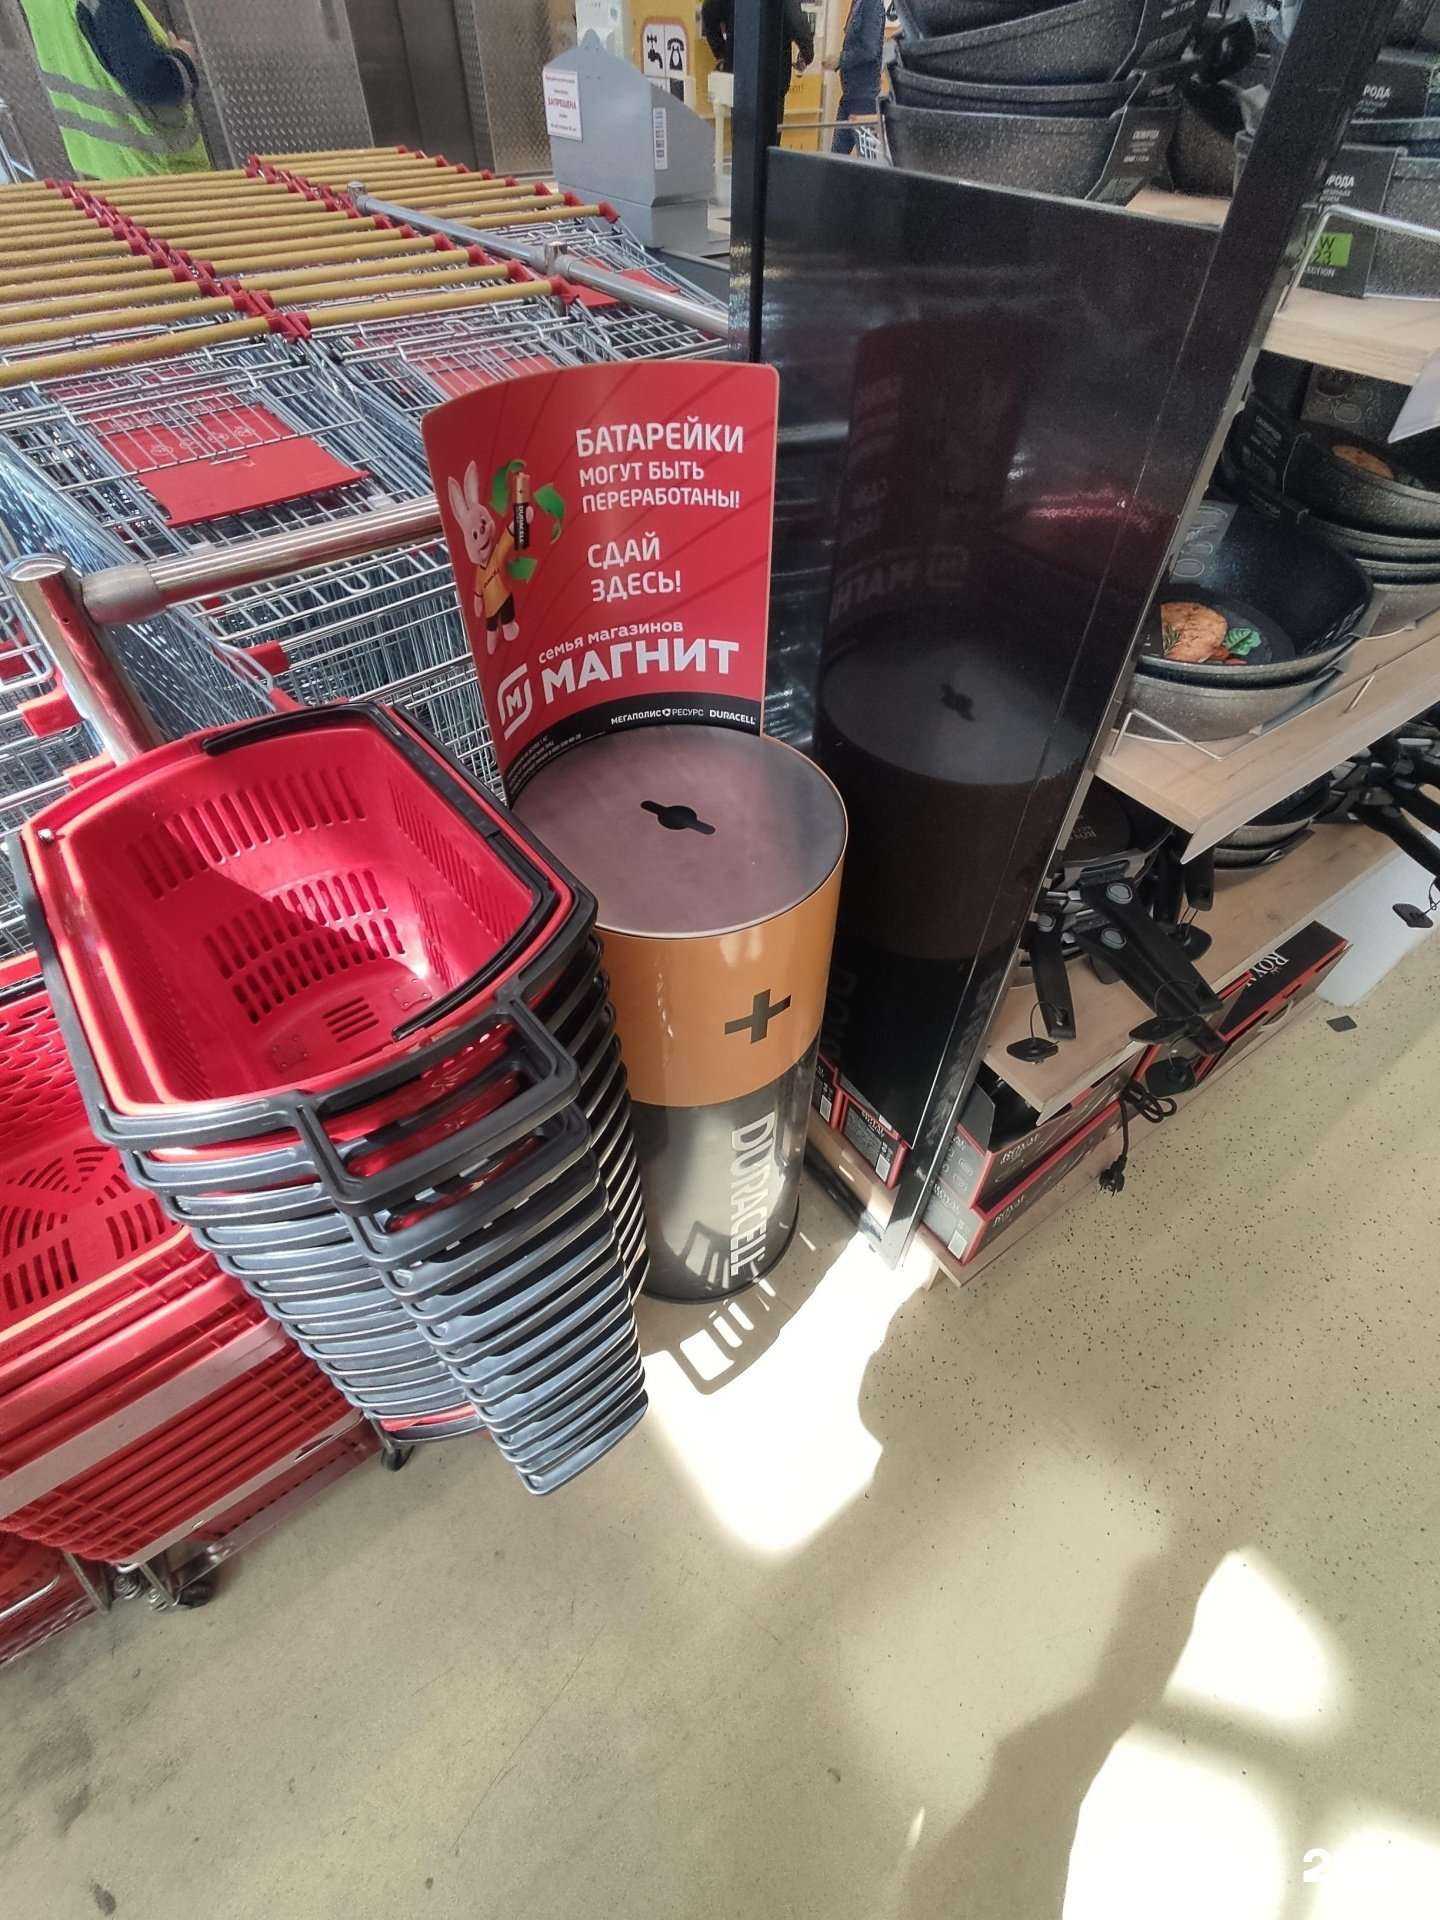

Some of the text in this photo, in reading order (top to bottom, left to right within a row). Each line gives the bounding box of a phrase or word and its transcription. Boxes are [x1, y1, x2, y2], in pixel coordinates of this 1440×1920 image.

[576, 415, 744, 458] БАТАРЕЙКИ
[579, 460, 705, 488] МОГУТ БЫТЬ
[582, 487, 740, 514] ПЕРЕРАБОТАНЫ!
[587, 531, 661, 570] СДАЙ
[590, 569, 682, 604] ЗДЕСЬ!
[538, 620, 684, 665] семья магазинов
[540, 637, 740, 706] МАГНИТ
[610, 707, 705, 726] МЕГАПОЛИС РЕСУРС
[709, 708, 756, 726] DURACELL
[730, 1111, 776, 1277] DURACELL
